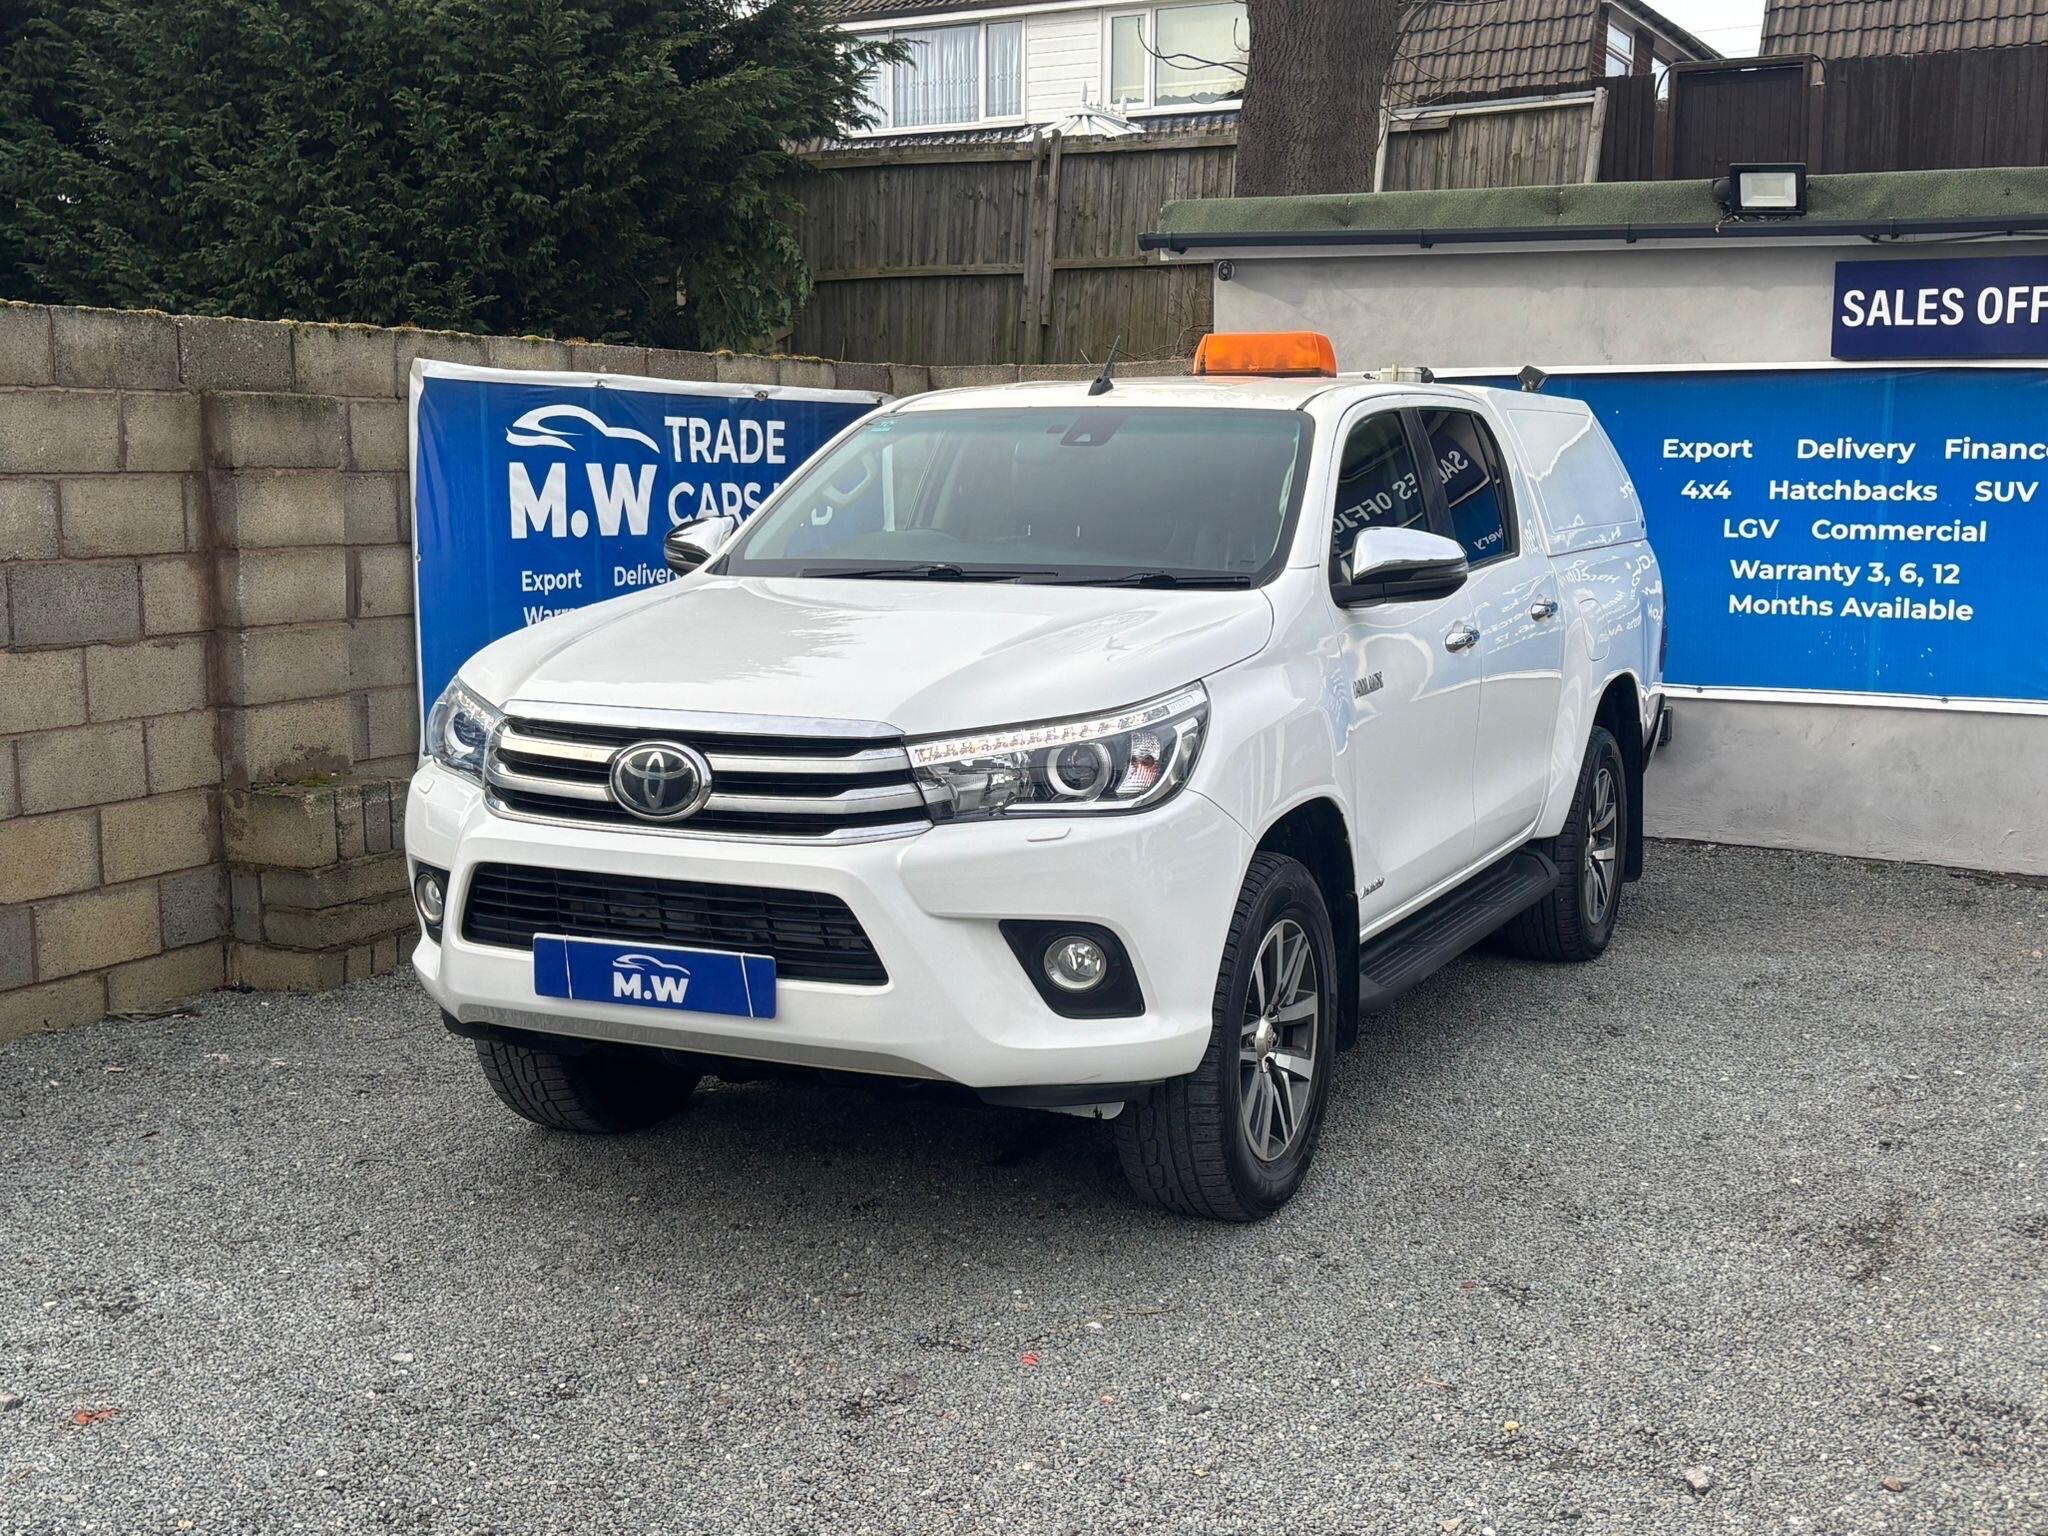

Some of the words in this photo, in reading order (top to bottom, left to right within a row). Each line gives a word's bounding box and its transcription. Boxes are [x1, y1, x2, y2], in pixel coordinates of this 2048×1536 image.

[1841, 288, 1965, 327] SALES
[664, 415, 786, 464] TRADE
[1663, 437, 1753, 463] Export
[1797, 436, 1916, 464] Delivery
[1944, 436, 2048, 460] Financ
[508, 461, 658, 539] M.W
[667, 481, 763, 528] CARS
[1681, 480, 1732, 500] 4x4
[1769, 479, 1938, 502] Hatchbacks
[1974, 480, 2039, 502] SUV
[1723, 518, 1780, 539] LGV
[1811, 519, 1987, 542] Commercial
[521, 569, 582, 595] Export
[1730, 559, 1861, 587] Warranty
[1867, 562, 1891, 587] 3,
[1899, 562, 1924, 588] 6,
[1932, 563, 1960, 585] 12
[1728, 594, 1834, 616] Months
[1840, 597, 1974, 621] Available
[612, 971, 690, 1004] M.W
